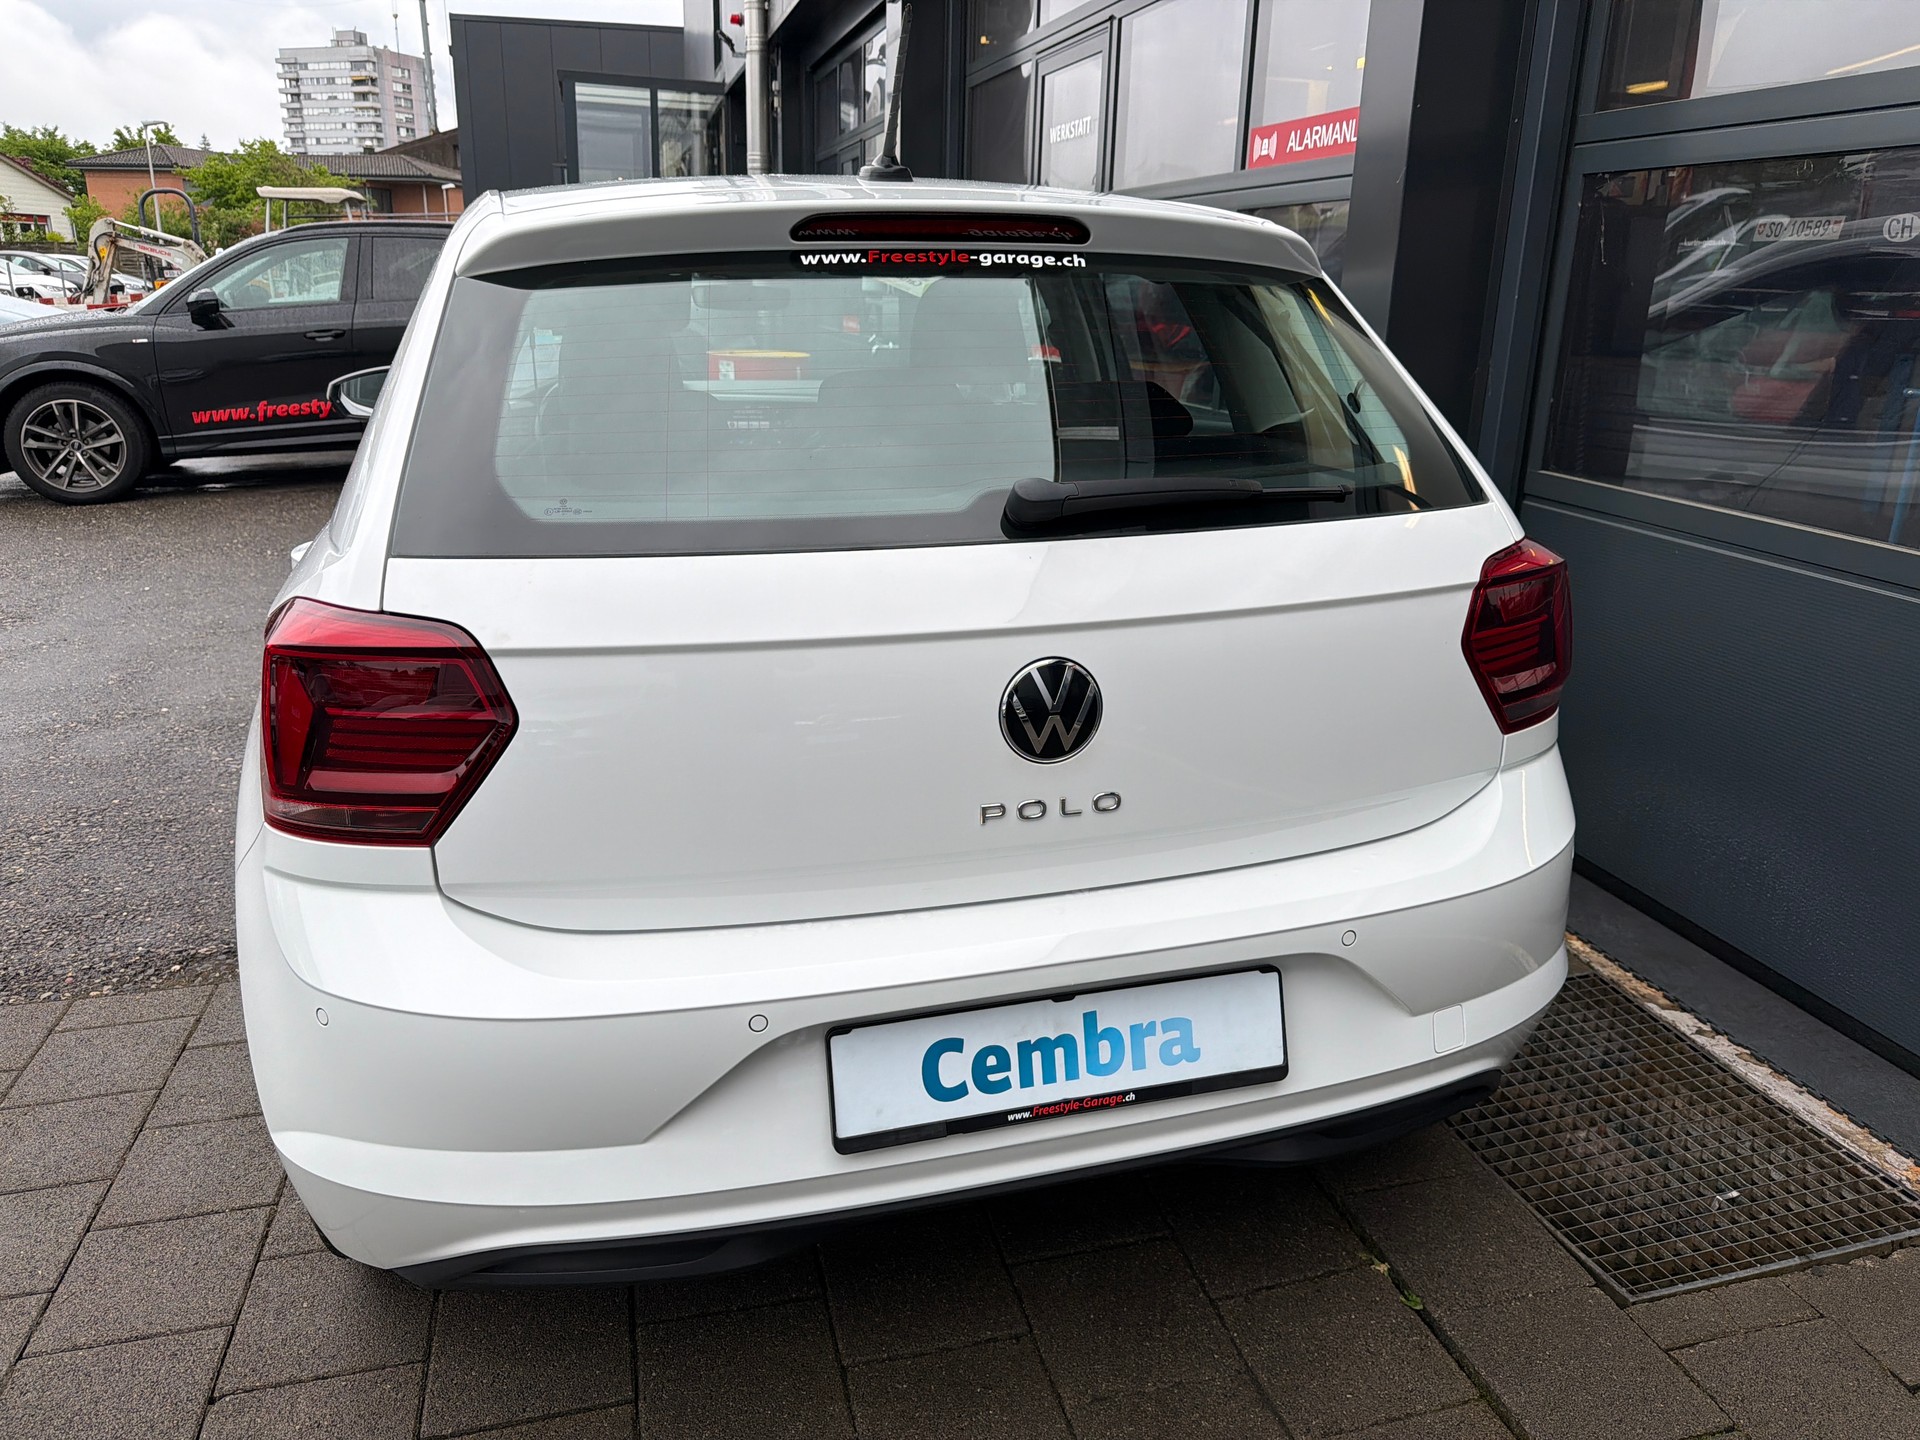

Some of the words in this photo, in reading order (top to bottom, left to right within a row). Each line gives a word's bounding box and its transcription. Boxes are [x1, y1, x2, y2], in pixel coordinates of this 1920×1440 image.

[1050, 116, 1091, 143] WERKSTATT
[1286, 118, 1358, 153] ALARMANL
[1887, 216, 1914, 239] CH
[800, 250, 1087, 268] www.Freestyle-garage.ch
[192, 399, 336, 424] www.freesty
[1004, 661, 1099, 757] VW
[980, 792, 1122, 825] POLO
[921, 1010, 1200, 1102] Cembra
[1007, 1092, 1136, 1121] www.Freestyle-Garage.ch
